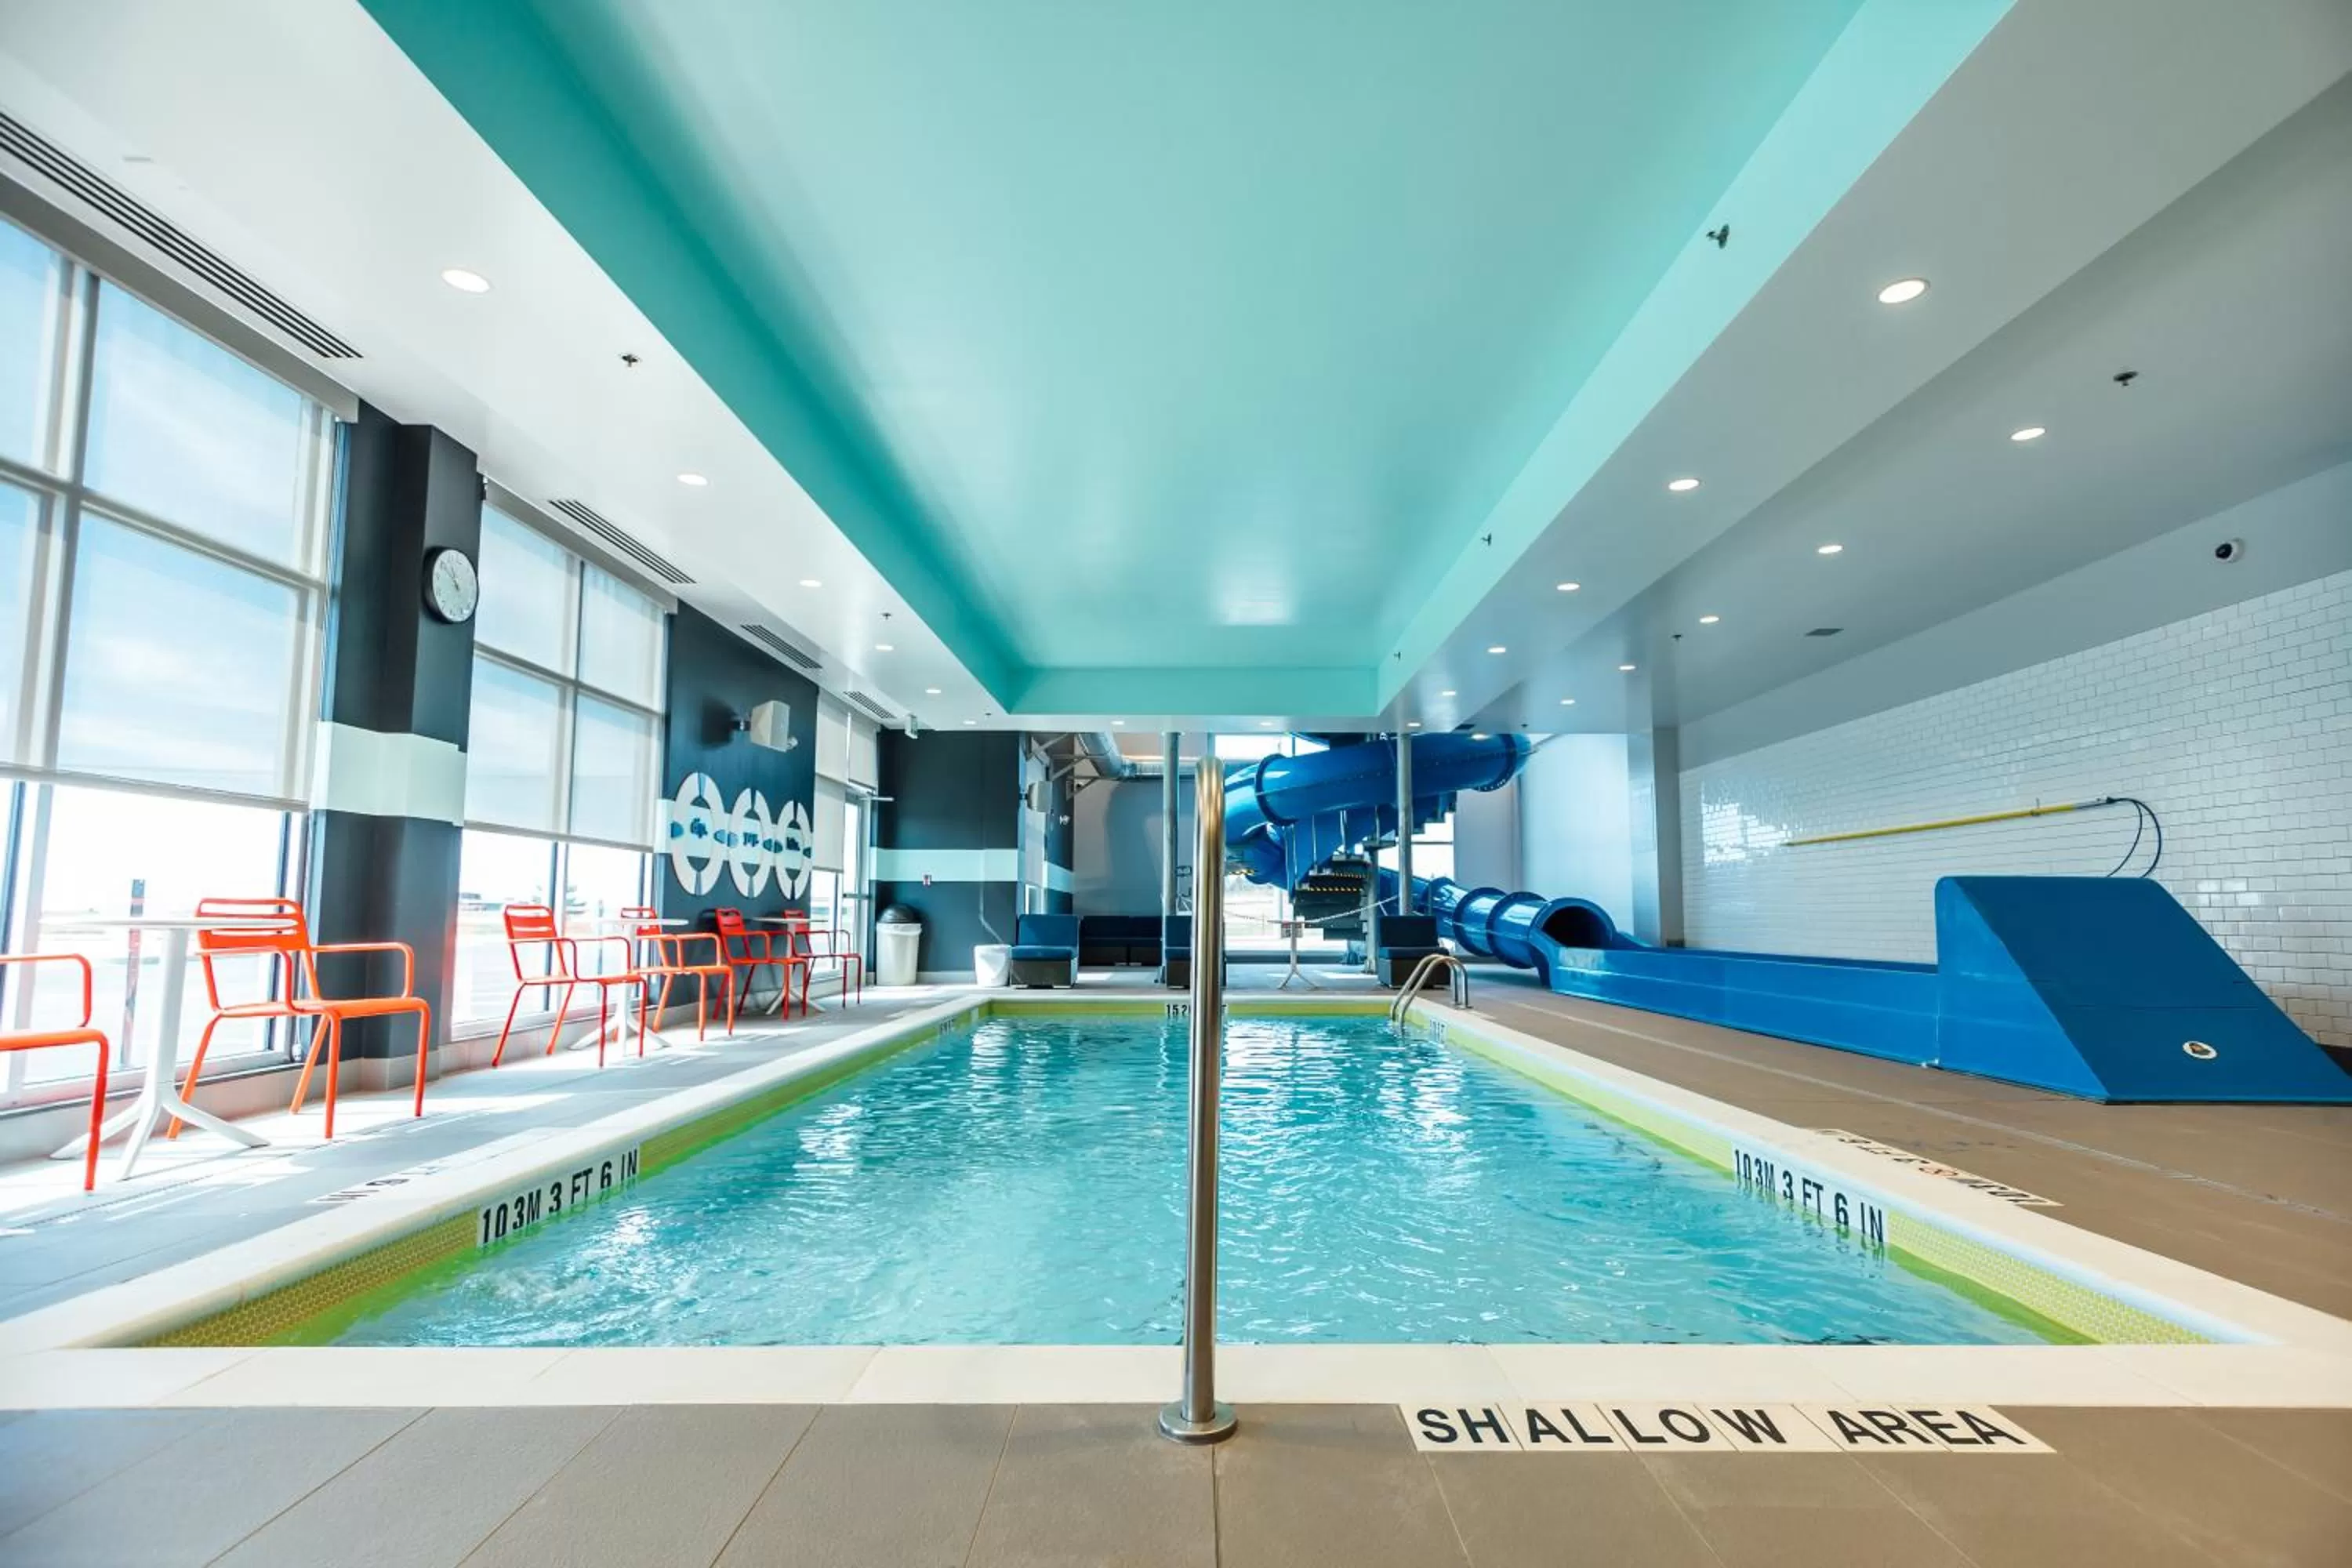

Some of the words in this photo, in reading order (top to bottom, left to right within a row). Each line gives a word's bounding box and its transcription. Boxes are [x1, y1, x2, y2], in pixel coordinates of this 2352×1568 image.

[549, 1181, 562, 1213] 3
[571, 1167, 593, 1204] FT
[600, 1160, 612, 1189] 6
[619, 1149, 637, 1181] IN
[1782, 1170, 1794, 1200] 3
[1802, 1177, 1824, 1214] FT
[1834, 1192, 1849, 1225] 6
[1860, 1202, 1882, 1242] IN
[1417, 1408, 1787, 1444] SHALLOW
[1827, 1409, 2027, 1445] AREA
